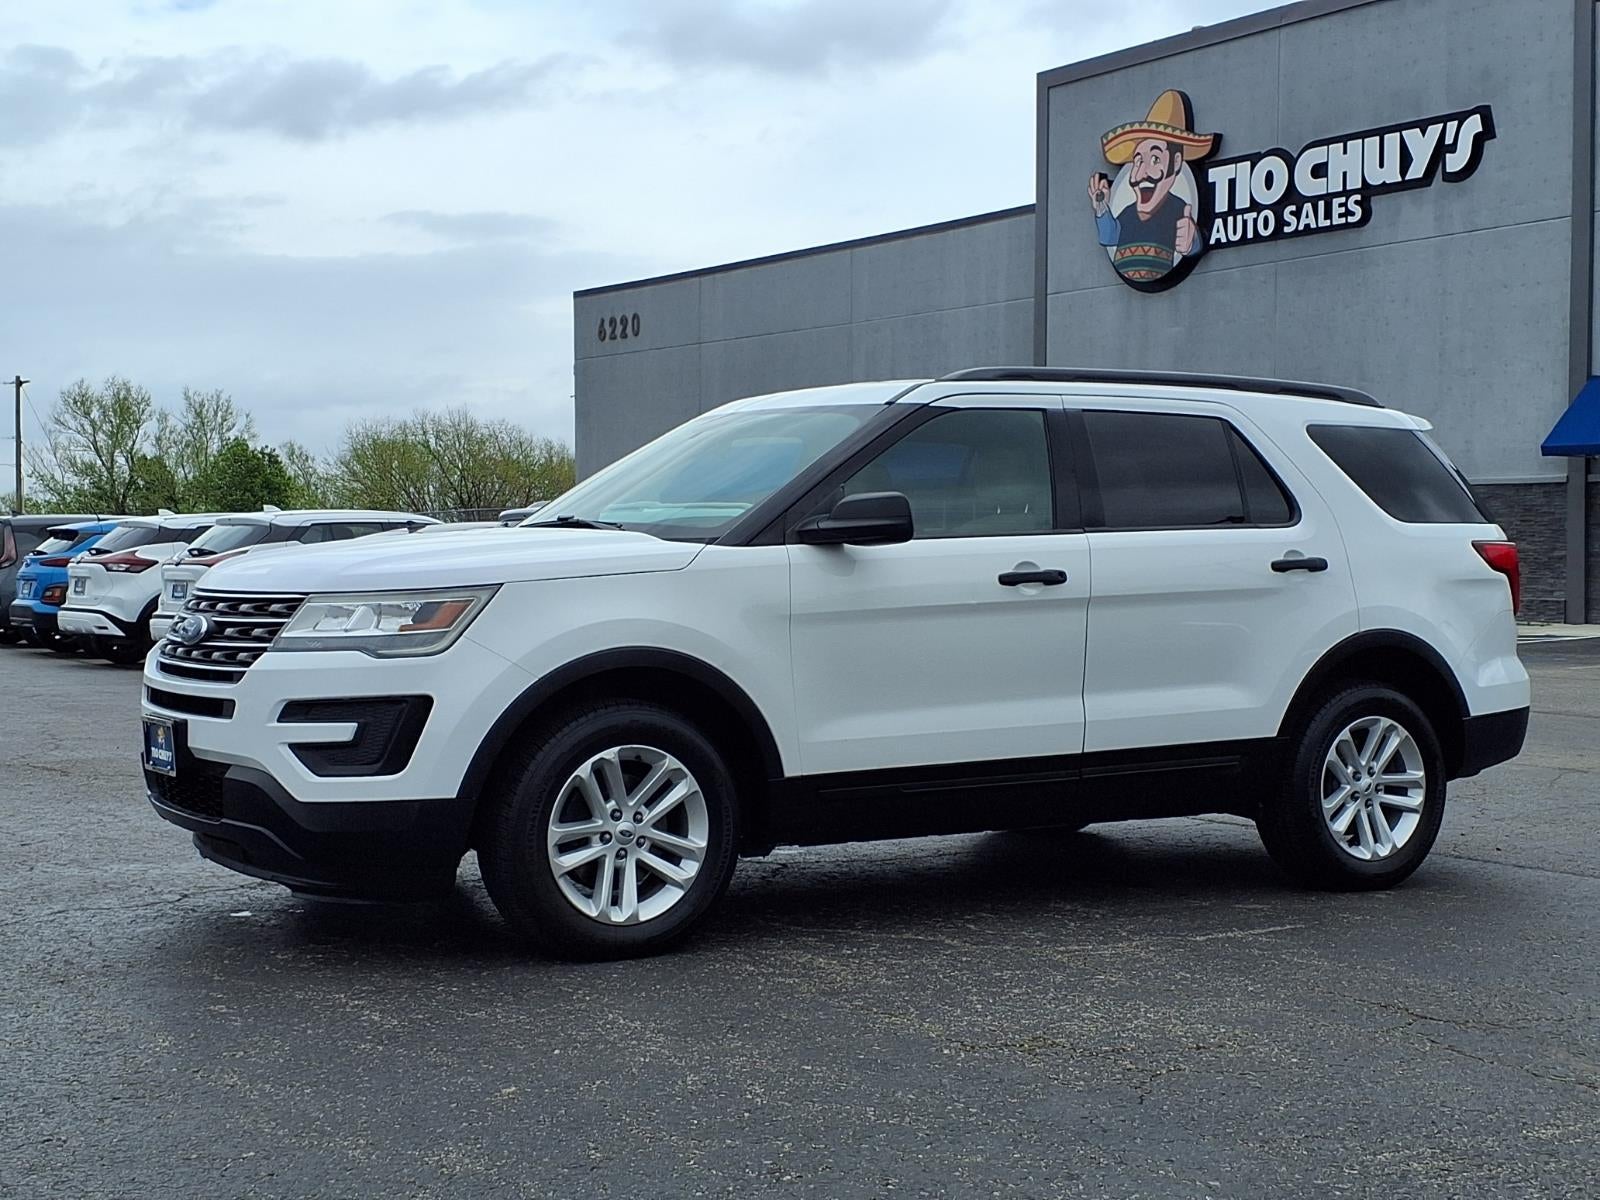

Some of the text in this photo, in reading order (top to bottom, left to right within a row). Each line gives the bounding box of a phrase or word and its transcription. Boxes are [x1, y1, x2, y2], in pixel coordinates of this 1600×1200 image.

[1208, 114, 1482, 214] TIO CHUY'S
[1209, 194, 1362, 245] AUTO SALES
[598, 312, 640, 342] 6220
